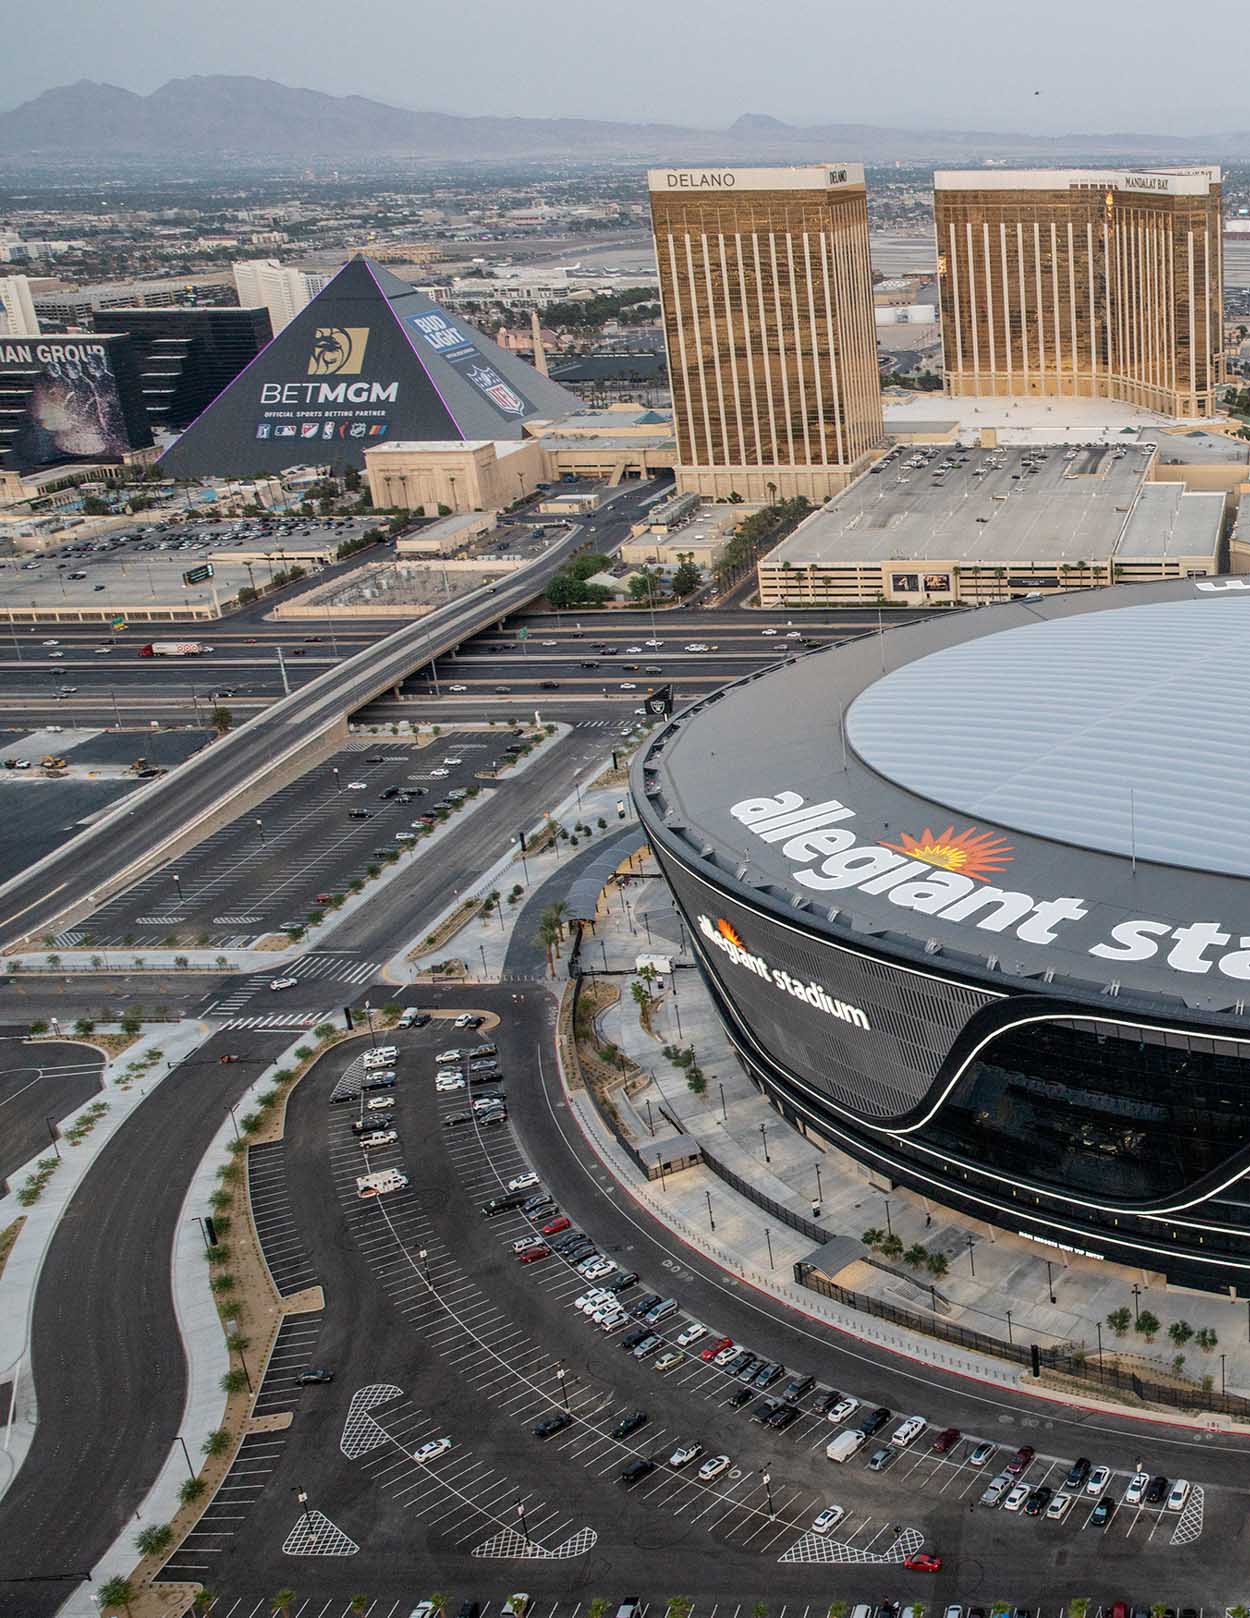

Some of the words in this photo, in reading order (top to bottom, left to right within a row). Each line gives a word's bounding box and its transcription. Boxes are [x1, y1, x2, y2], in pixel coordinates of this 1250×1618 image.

[667, 173, 735, 187] DELANO
[829, 170, 847, 184] DELANO
[1125, 177, 1156, 190] MANDALAY
[1157, 179, 1169, 191] BAY
[412, 315, 447, 334] BUD
[423, 327, 465, 349] LIGHT
[0, 345, 33, 363] AN
[260, 382, 399, 404] BETMGM
[355, 409, 386, 417] PARTNER
[730, 791, 1089, 944] allegiant
[697, 914, 773, 983] allegiant
[772, 968, 871, 1031] stadium
